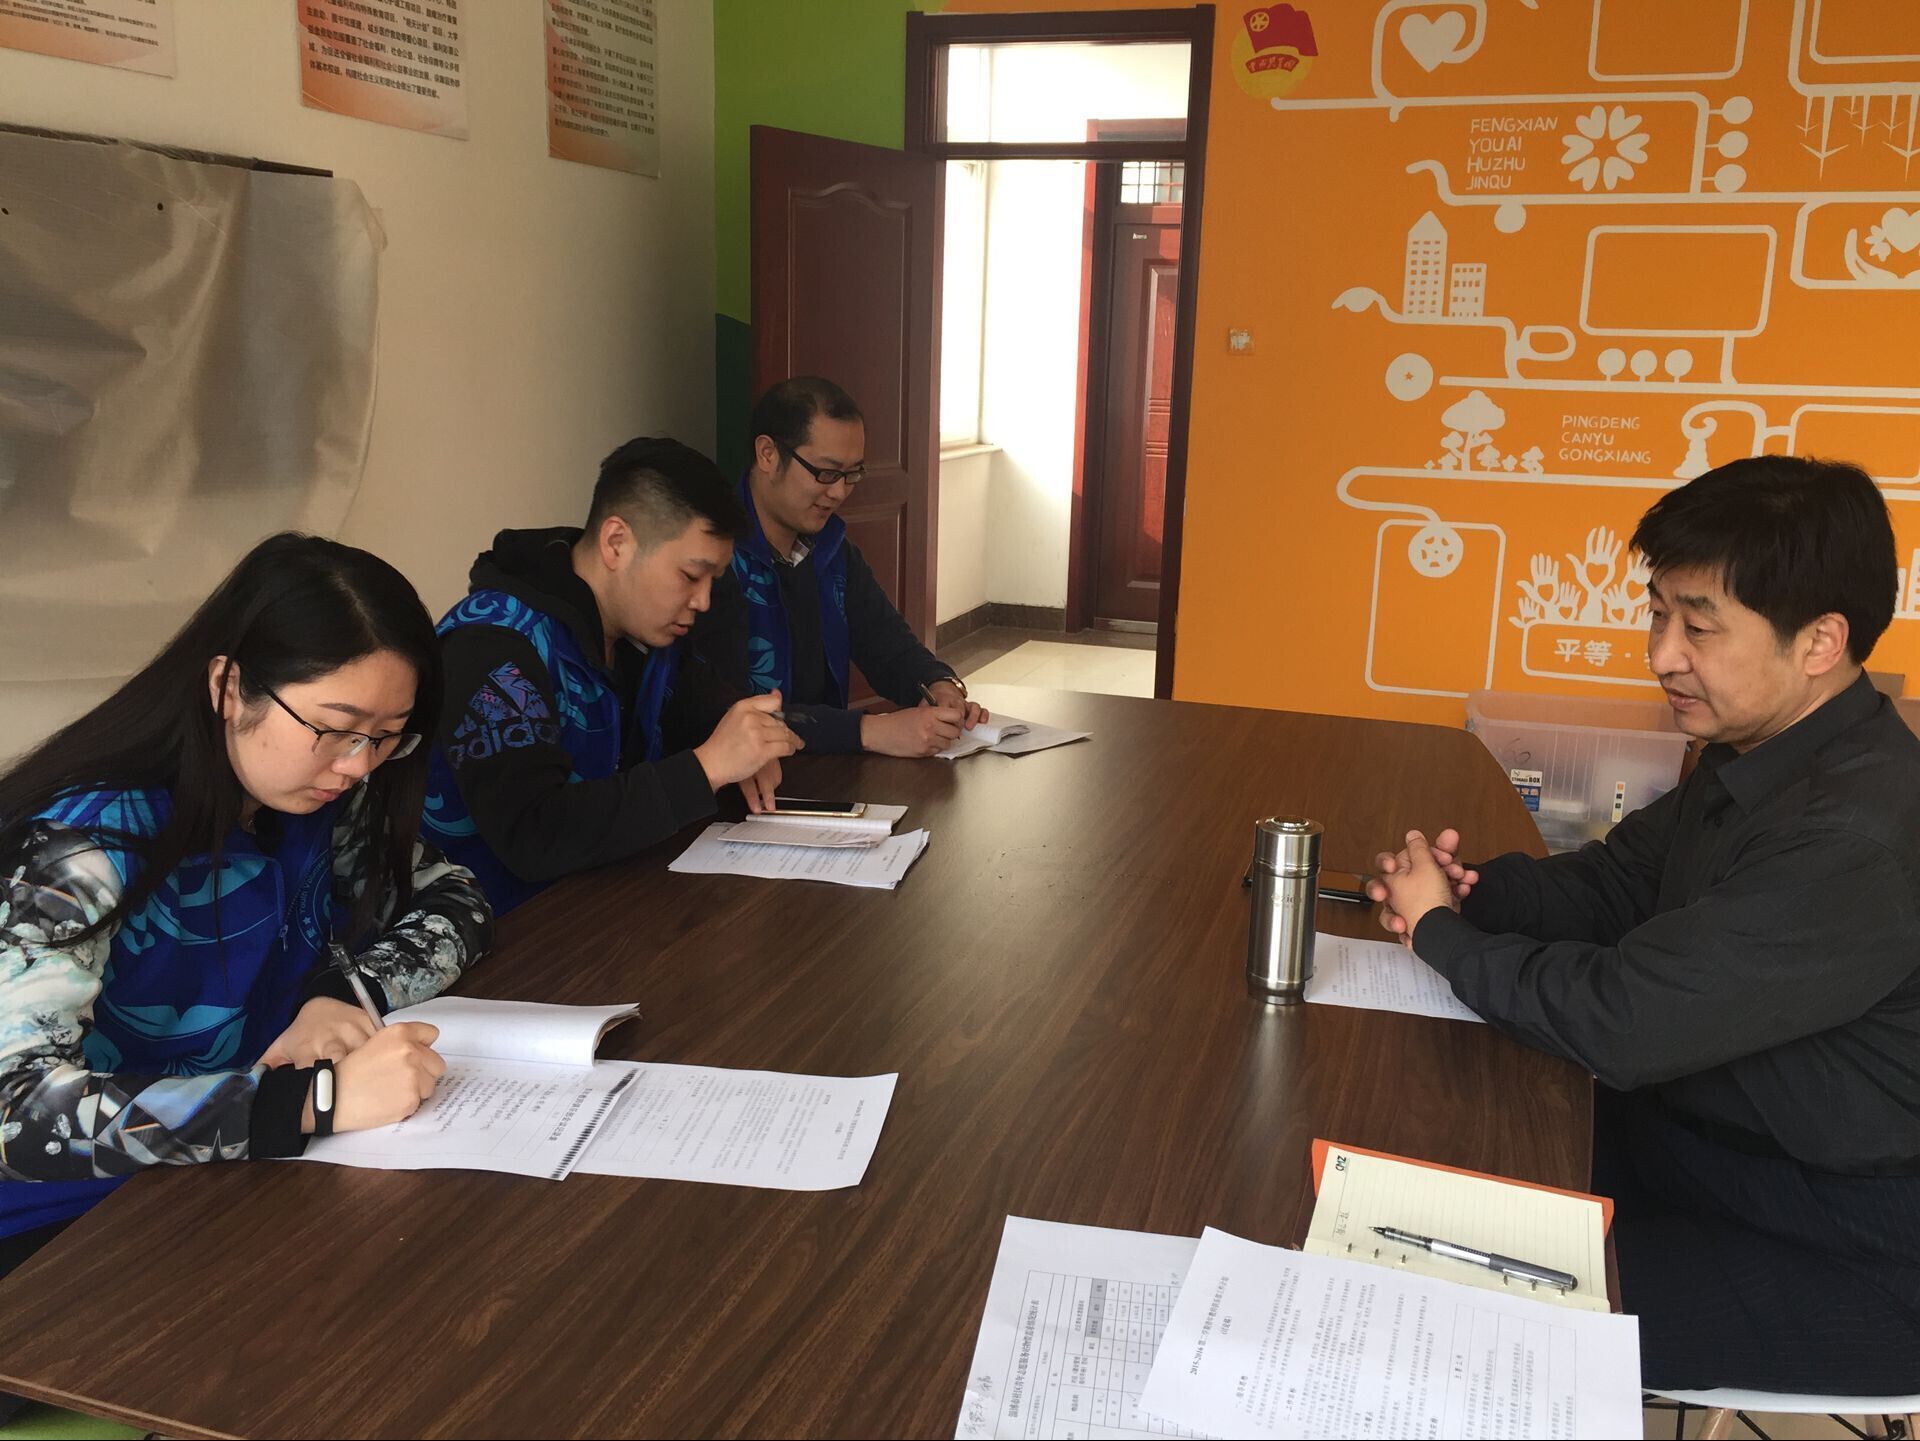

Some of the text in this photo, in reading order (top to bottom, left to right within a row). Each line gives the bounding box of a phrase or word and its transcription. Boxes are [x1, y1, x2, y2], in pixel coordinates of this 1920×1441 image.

[1470, 116, 1558, 134] FENGXIAN
[1466, 156, 1526, 174] HUZHU
[1465, 174, 1512, 190] JINQU
[1561, 414, 1640, 430] PINGDENG
[1561, 431, 1615, 446] CANYU
[1558, 447, 1651, 465] GONGXIANG
[1528, 776, 1541, 784] BOX
